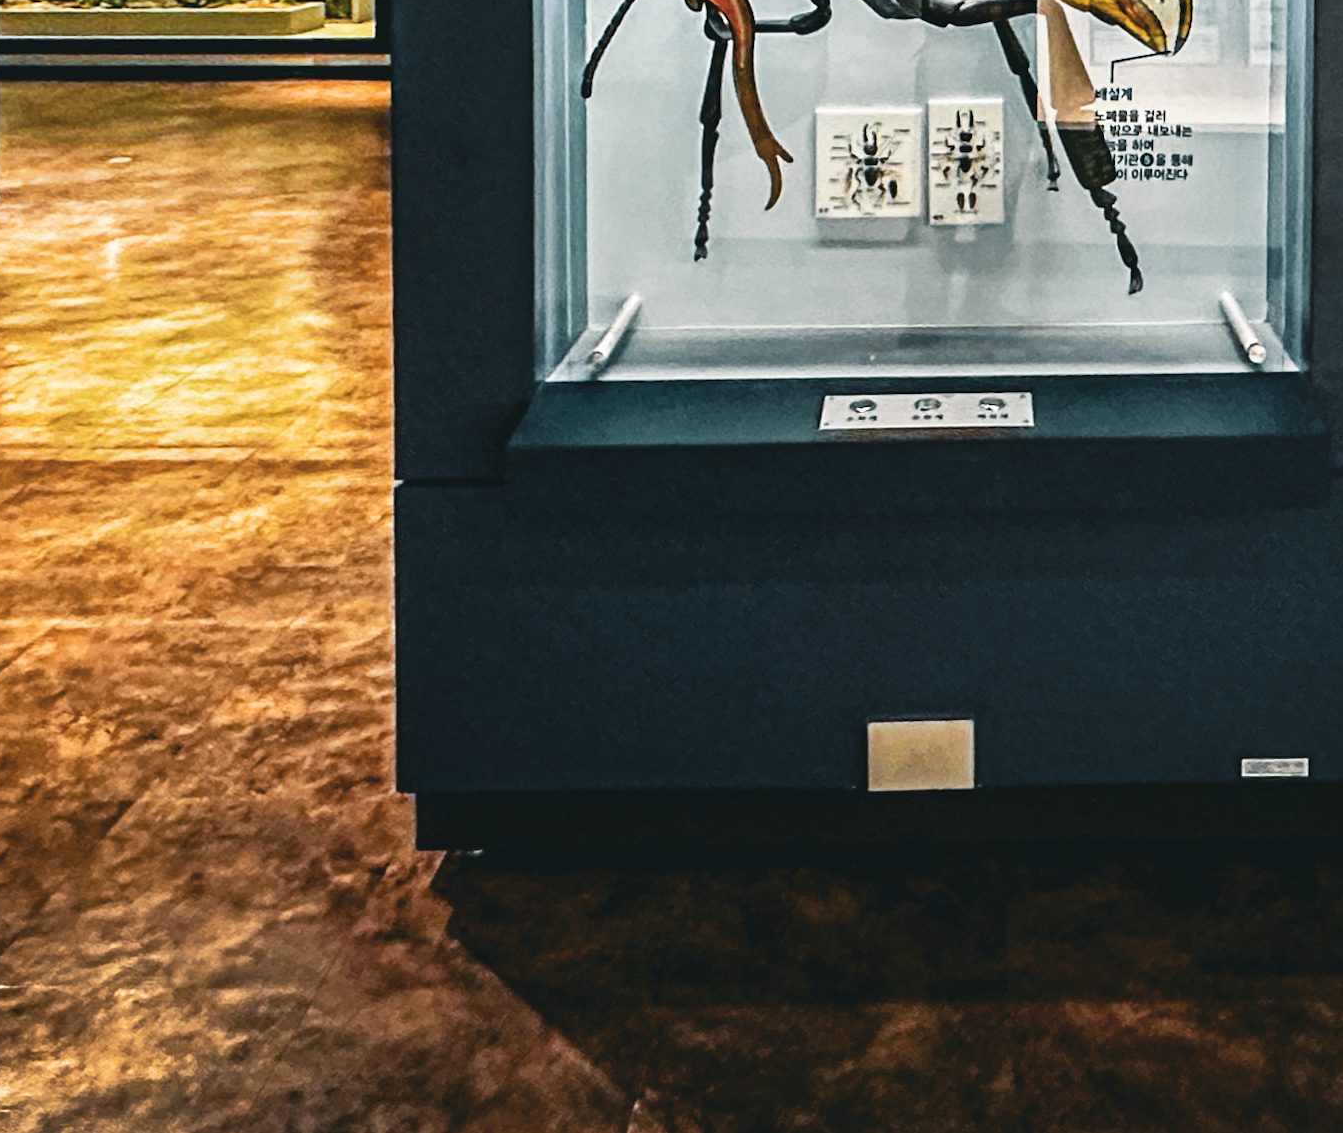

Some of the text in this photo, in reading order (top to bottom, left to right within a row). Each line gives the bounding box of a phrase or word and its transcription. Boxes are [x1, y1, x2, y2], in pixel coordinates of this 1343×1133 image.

[1110, 124, 1142, 137] 밖으로
[1148, 124, 1193, 138] 내보내는
[1132, 139, 1154, 151] 하며
[1131, 168, 1188, 181] 이루어진다
